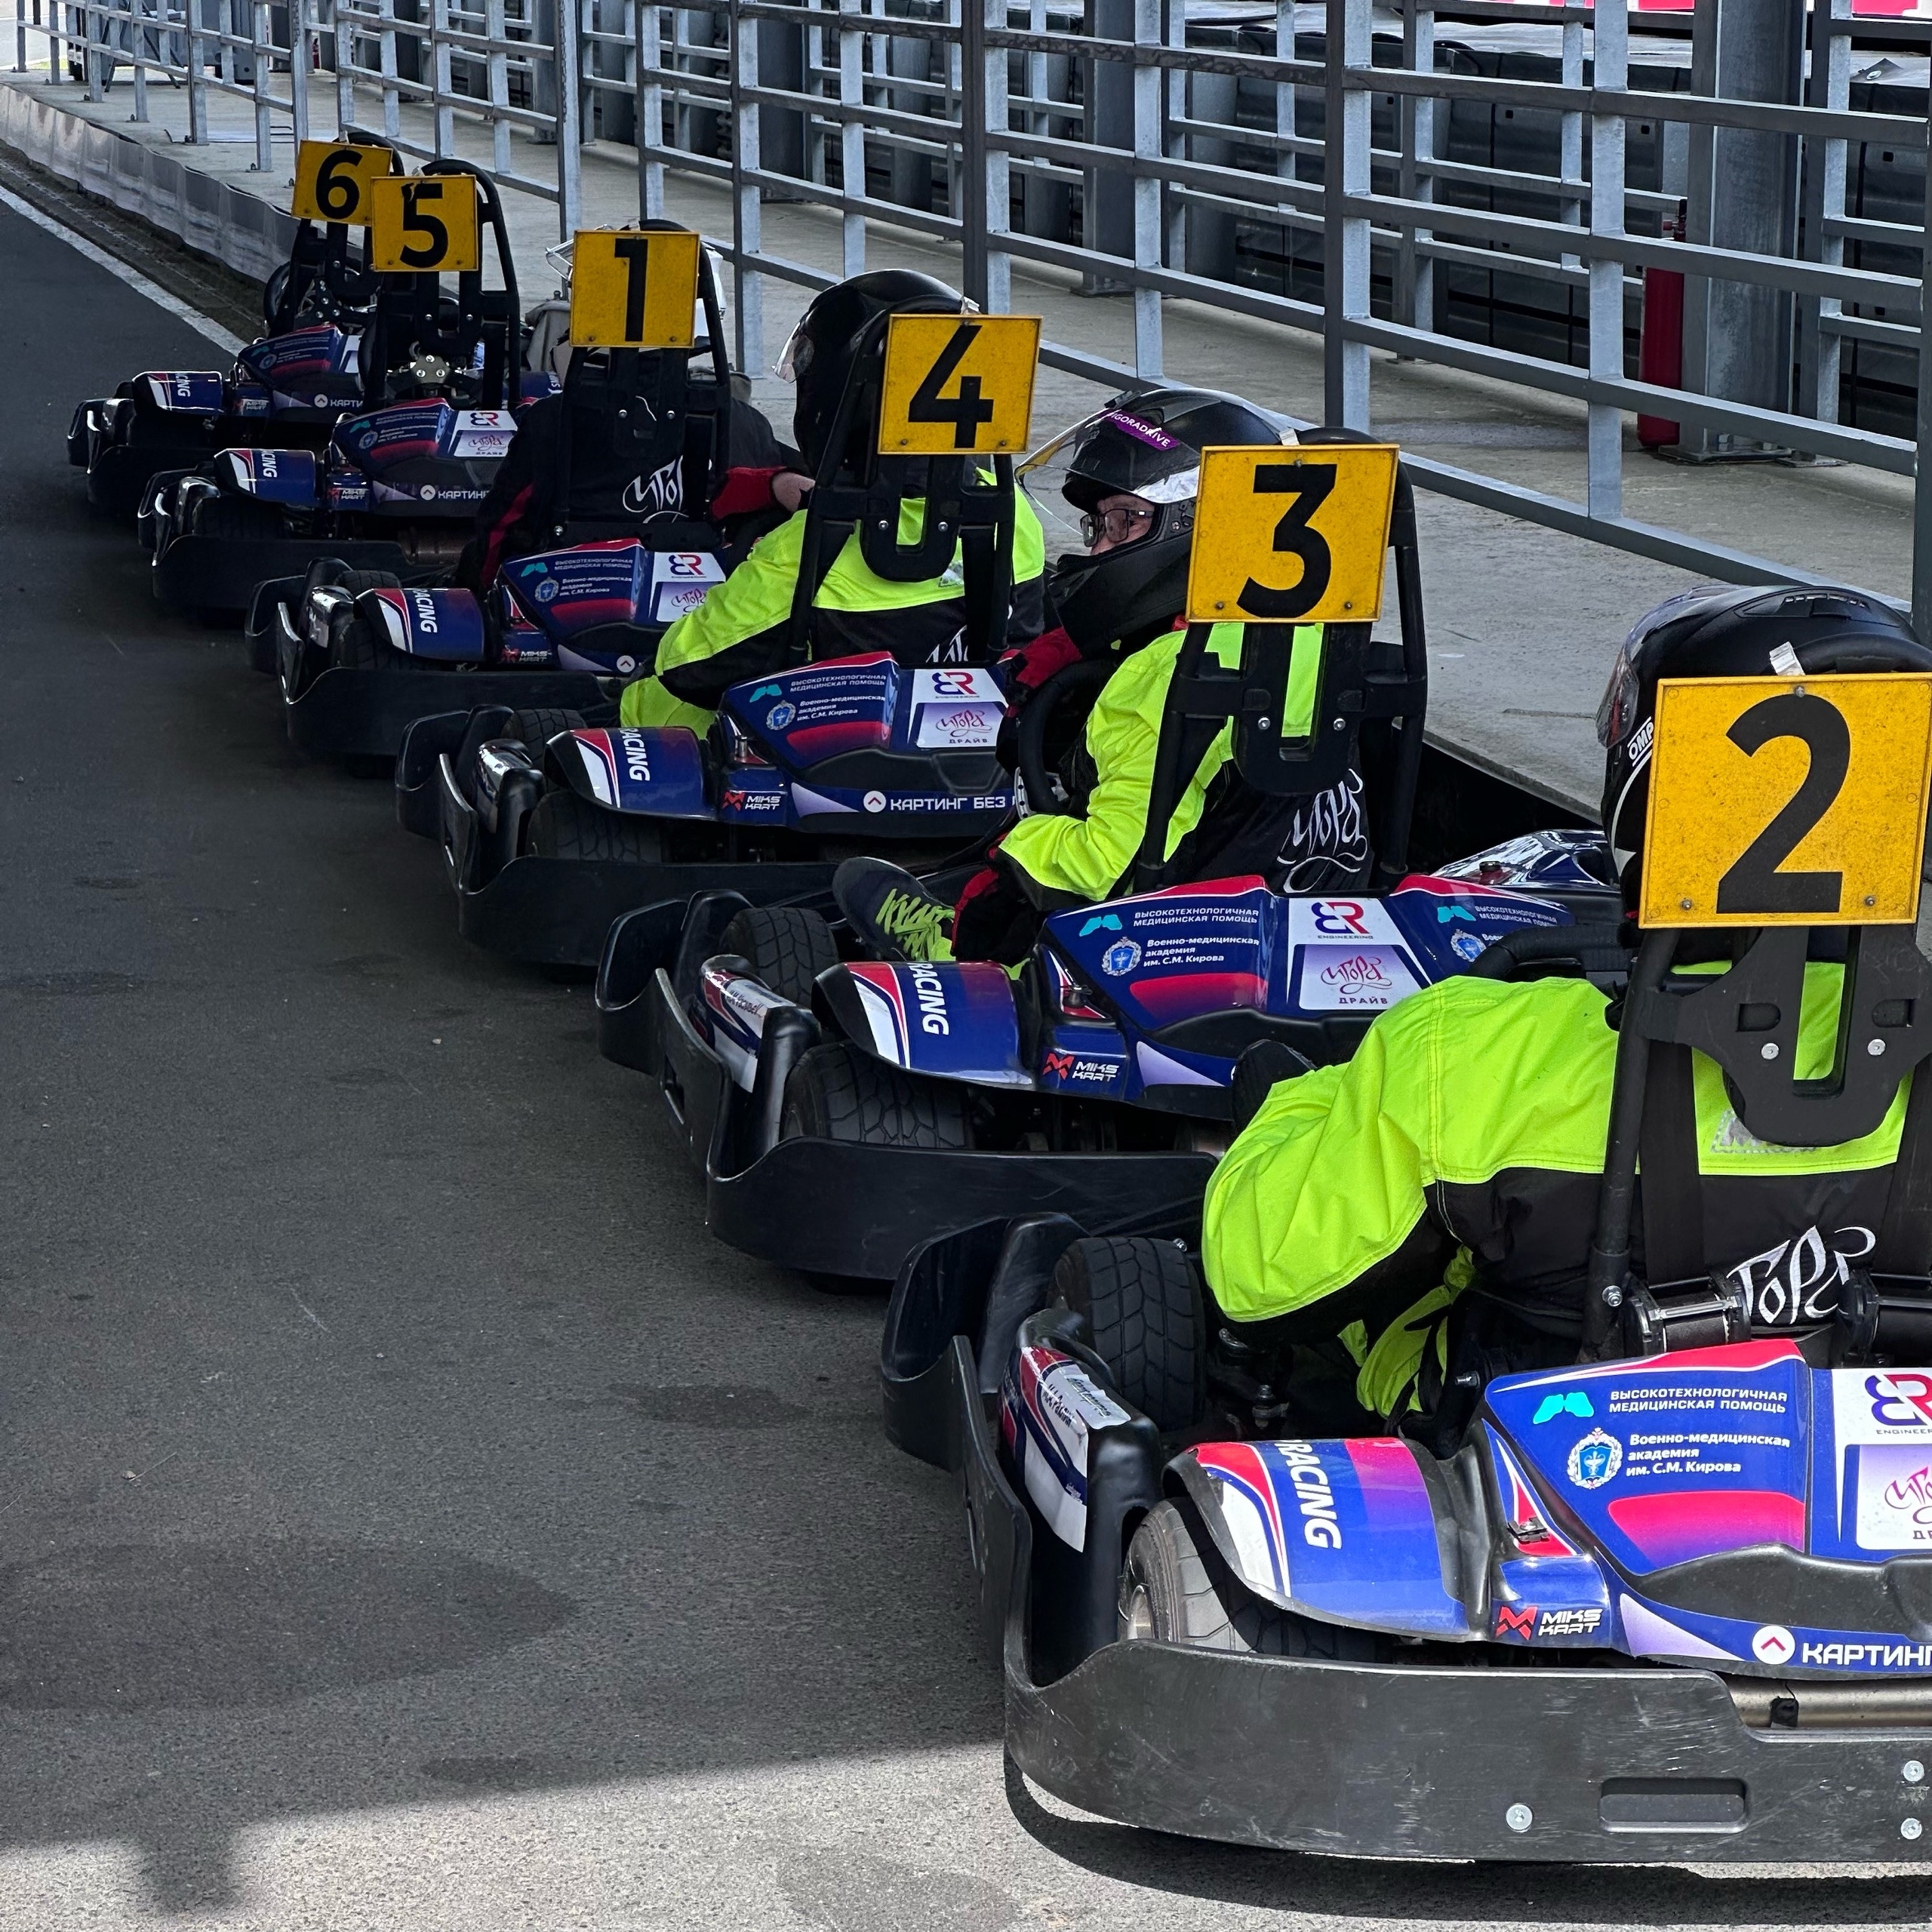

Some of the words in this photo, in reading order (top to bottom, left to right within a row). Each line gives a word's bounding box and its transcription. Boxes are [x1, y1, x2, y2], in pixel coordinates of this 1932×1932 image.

[315, 150, 364, 220] 6
[399, 183, 449, 268] 5
[614, 238, 649, 343] 1
[908, 325, 994, 449] 4
[330, 399, 363, 408] КАРТИ
[1236, 463, 1337, 618] 3
[789, 681, 847, 693] МЕДИЦИНСКАЯ
[791, 675, 887, 687] ВЫСОКОТЕХНОЛОГИЧНАЯ
[800, 695, 886, 707] Военно-медицинская
[798, 704, 837, 715] академия
[829, 708, 858, 717] Кирова
[1629, 721, 1654, 761] OMP
[891, 797, 968, 811] КАРТИНГ
[974, 796, 1006, 809] БЕЗ
[1717, 694, 1850, 914] 2
[1133, 915, 1208, 927] МЕДИЦИНСКАЯ
[1211, 915, 1257, 924] ПОМОЩЬ
[1134, 908, 1259, 919] ВЫСОКОТЕХНОЛОГИЧНАЯ
[1146, 937, 1260, 947] Военно-медицинская
[1145, 947, 1196, 957] академия
[1186, 955, 1224, 963] Кирова
[907, 962, 949, 1035] RACING
[1339, 996, 1388, 1004] ДРАЙВ
[1075, 1061, 1119, 1073] MIKS
[1072, 1072, 1117, 1081] KART
[1610, 1387, 1788, 1403] ВЫСОКОТЕХНОЛОГИЧНАЯ
[1608, 1398, 1715, 1414] МЕДИЦИНСКАЯ
[1720, 1399, 1786, 1414] ПОМОЩЬ
[1629, 1432, 1791, 1447] Военно-медицинская
[1628, 1447, 1700, 1463] академия
[1626, 1466, 1650, 1477] им.
[1653, 1462, 1684, 1475] С.М.
[1685, 1460, 1742, 1476] Кирова
[1274, 1442, 1343, 1549] RACING
[1542, 1608, 1602, 1624] MIKS
[1538, 1622, 1601, 1636] KART
